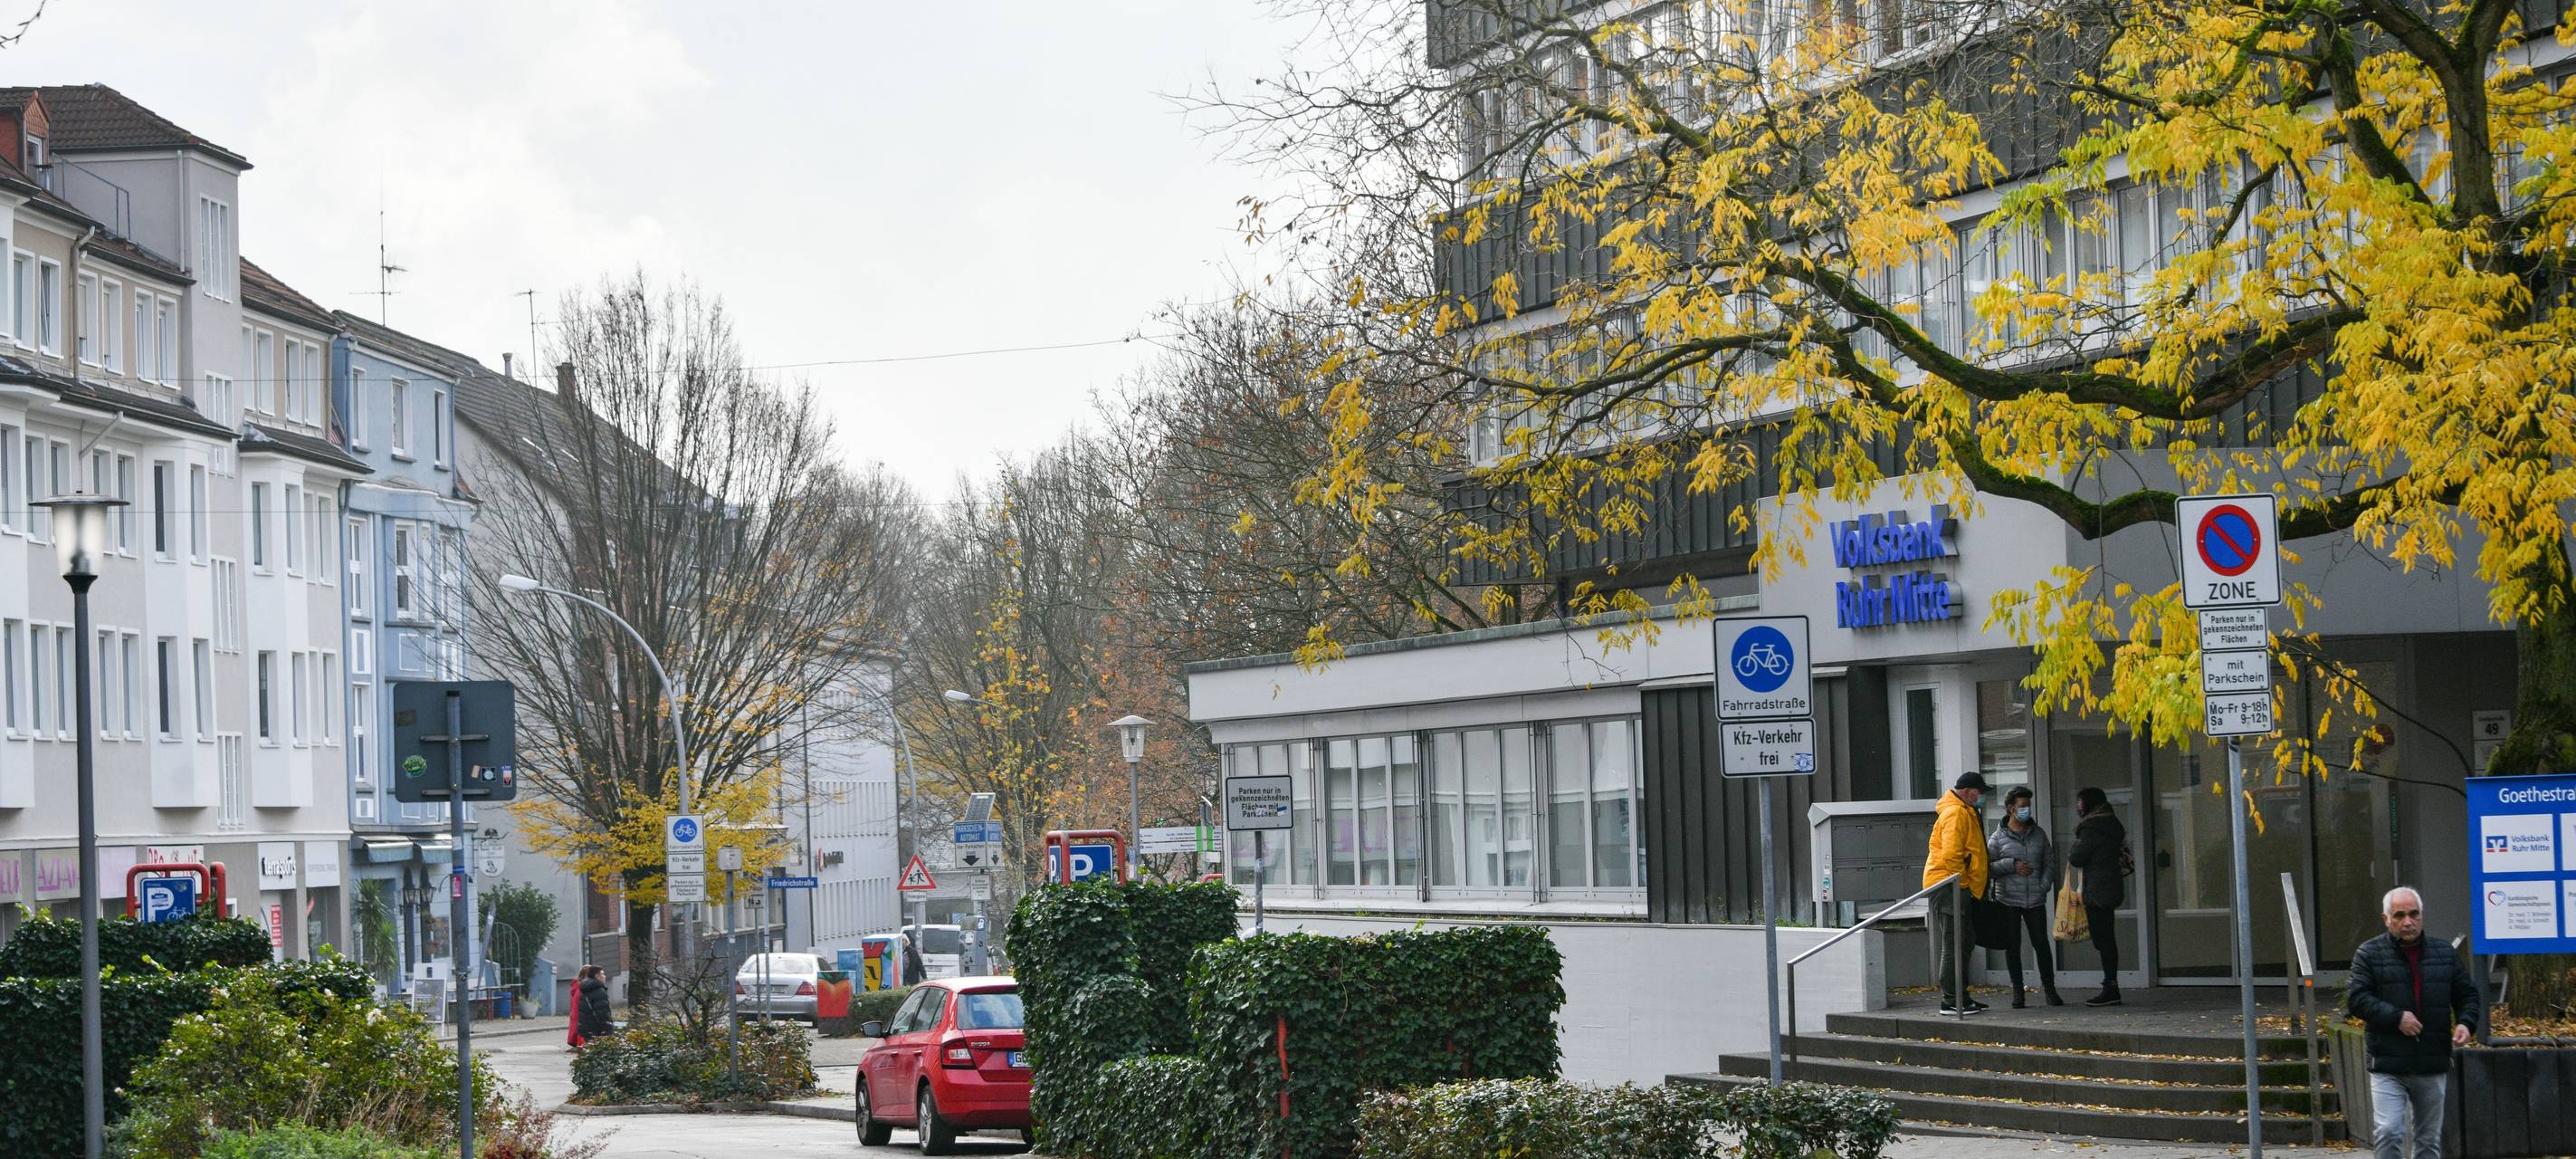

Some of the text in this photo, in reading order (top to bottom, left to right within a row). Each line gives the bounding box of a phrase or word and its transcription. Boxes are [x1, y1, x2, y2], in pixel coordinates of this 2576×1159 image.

[1829, 504, 1948, 569] Volksbank
[2208, 580, 2256, 599] ZONE
[1836, 570, 1951, 629] Ruhr Mitte
[2210, 615, 2234, 624] Parken
[2203, 623, 2264, 635] gekennzeichneten
[2220, 635, 2247, 644] Flächen
[2227, 659, 2244, 669] mit
[2208, 672, 2265, 684] Parkschein
[1722, 697, 1806, 711] Fahrradstraße
[2209, 700, 2268, 714] Mo-Fr 9-18h
[2210, 713, 2268, 726] Sa 9-12h
[2485, 723, 2499, 735] 49
[1733, 728, 1803, 745] Kfz-Verkehr
[1759, 751, 1779, 766] frei
[1238, 787, 1262, 795] Parken
[2499, 786, 2576, 804] Goethestra
[1230, 795, 1290, 803] gekennzeichneten
[2511, 834, 2550, 843] Volksbank
[2512, 843, 2551, 852] Ruhr Mitte
[1069, 854, 1093, 882] P
[771, 878, 815, 887] Friedrichstraße
[148, 887, 174, 923] P
